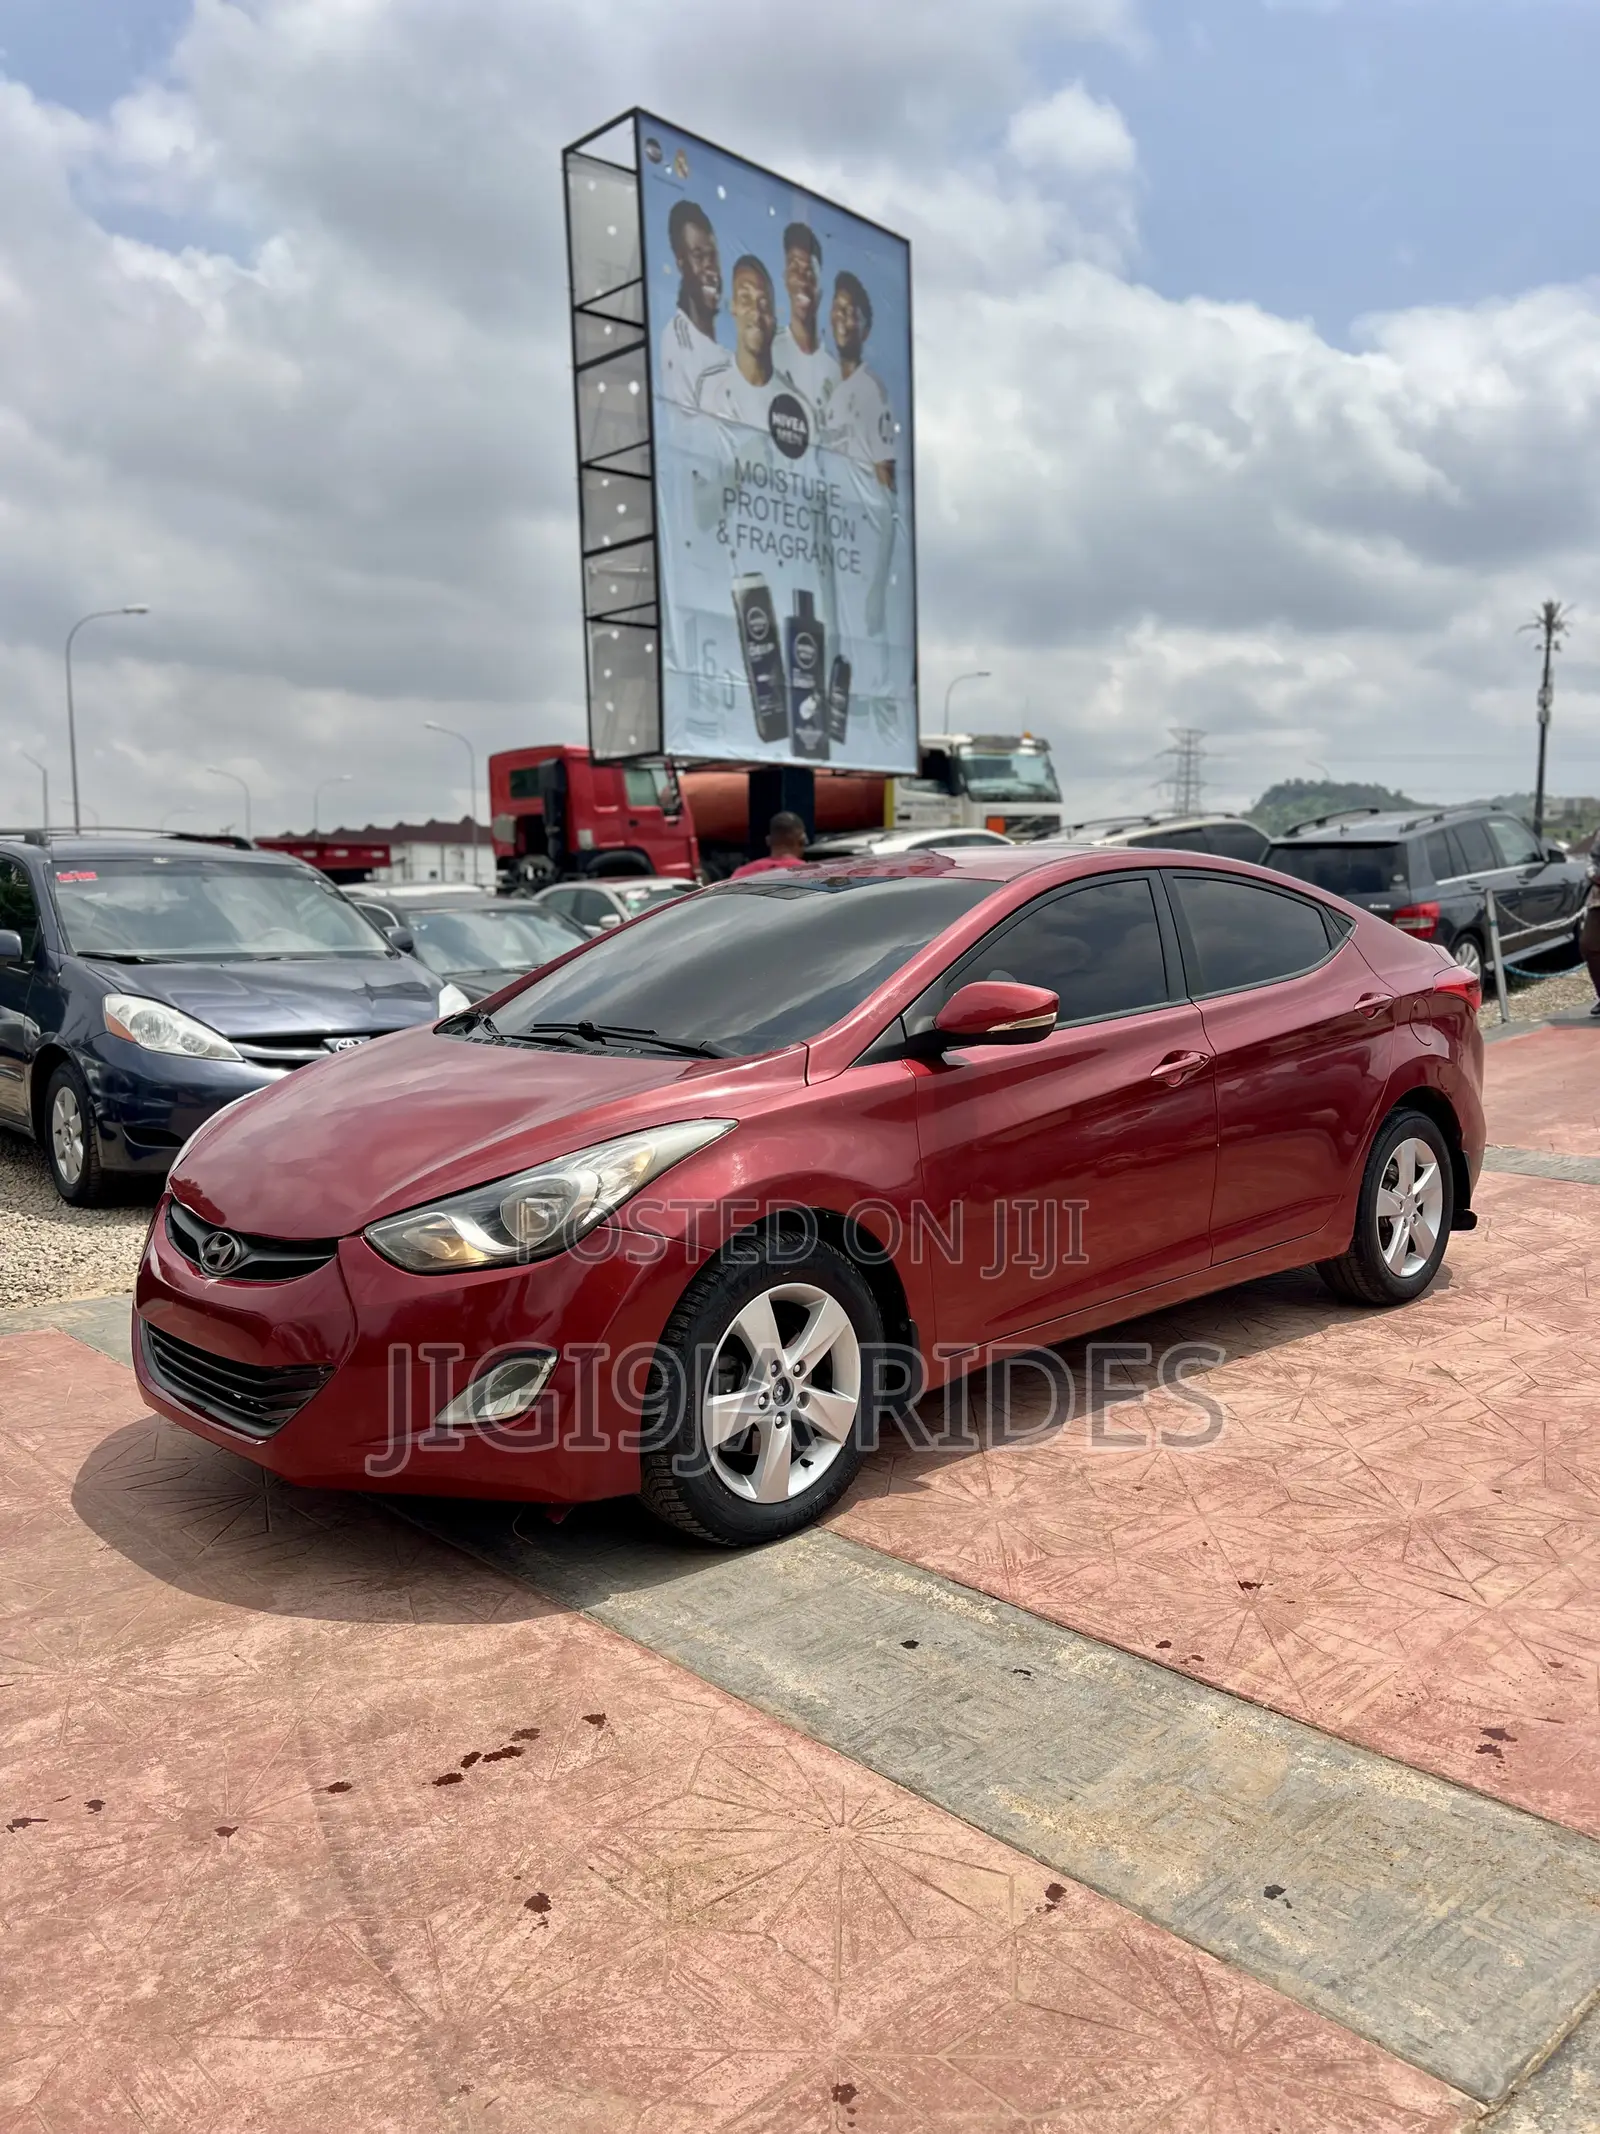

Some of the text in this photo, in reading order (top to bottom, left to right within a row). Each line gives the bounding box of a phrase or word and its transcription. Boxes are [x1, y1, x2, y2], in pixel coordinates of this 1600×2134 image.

[771, 411, 807, 434] NIVEA
[723, 487, 855, 542] PROTECTION
[717, 519, 861, 574] & FRAGRANCE
